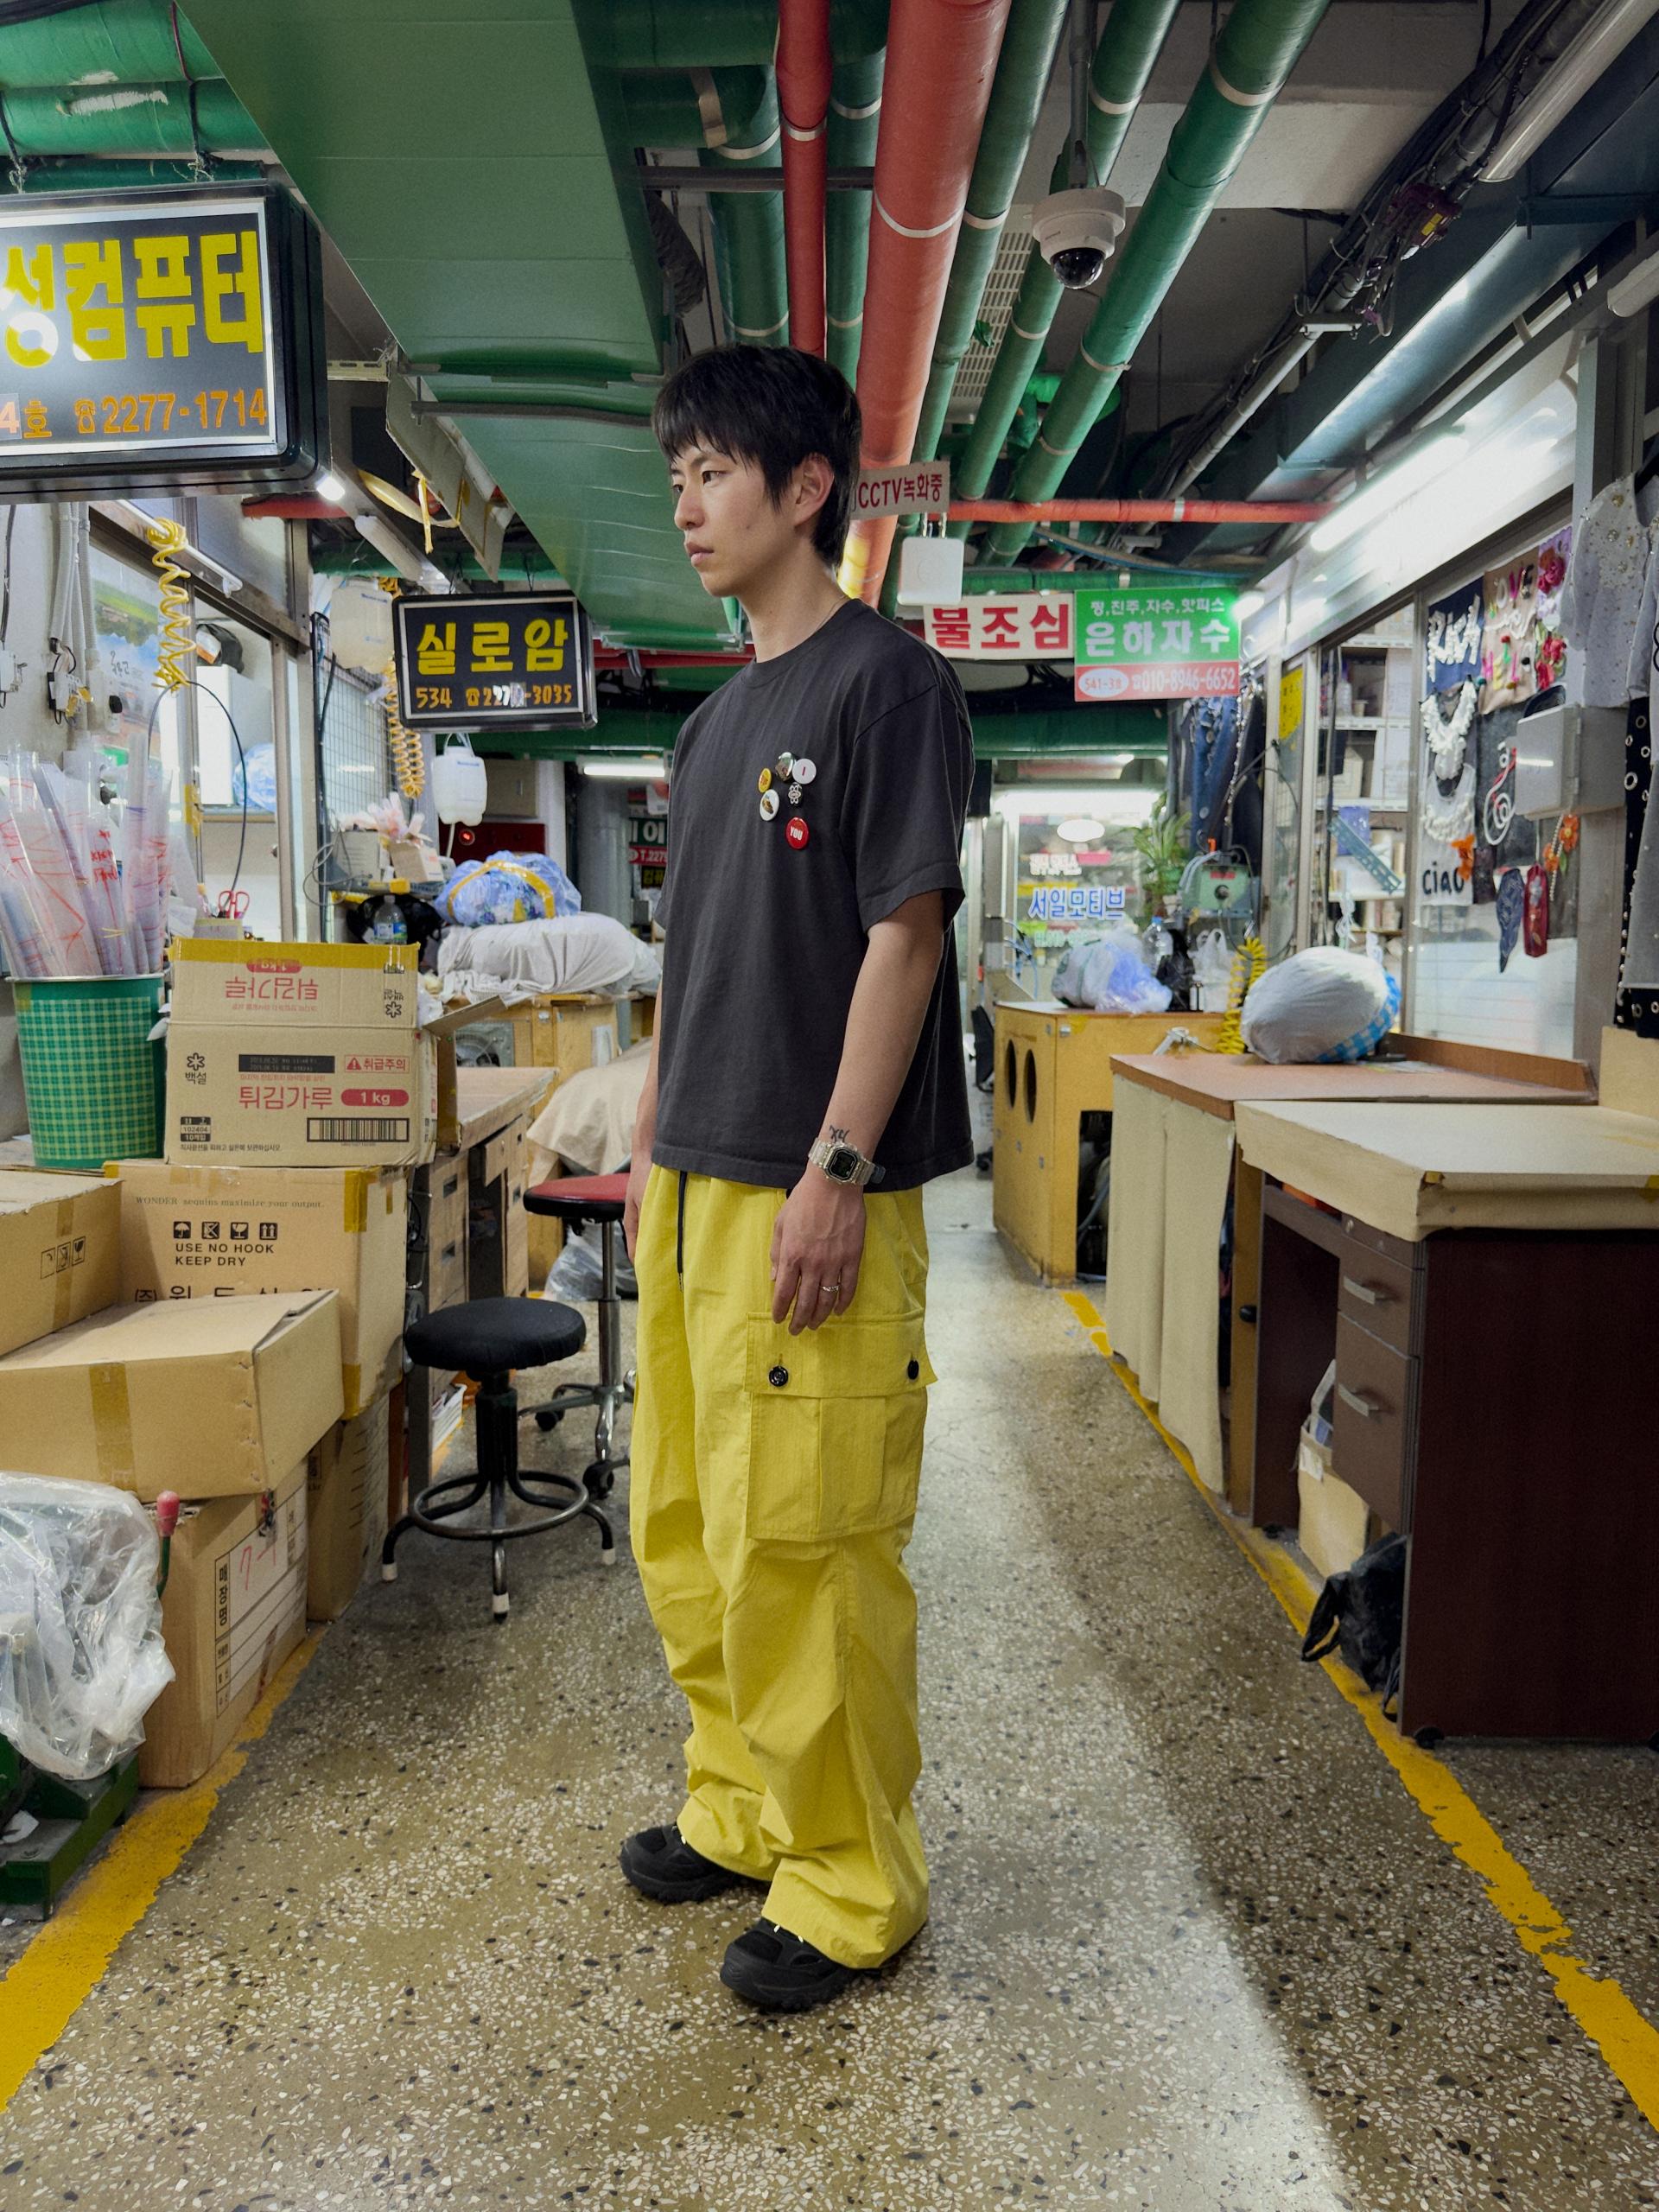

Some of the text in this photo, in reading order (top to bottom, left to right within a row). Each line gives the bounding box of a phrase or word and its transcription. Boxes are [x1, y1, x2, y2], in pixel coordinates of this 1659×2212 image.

[0, 231, 264, 368] 성컴퓨터
[102, 389, 267, 434] 2277-1714
[858, 474, 943, 509] CCTV녹화중
[931, 604, 1069, 650] 불조심
[1085, 620, 1230, 657] 은하자수
[416, 619, 569, 676] 실로암
[416, 686, 453, 709] 534
[1029, 887, 1125, 920] 서일모티브
[225, 976, 319, 1001] 튀김가루
[185, 1072, 207, 1085] 백설
[363, 1057, 407, 1071] 취급주의
[238, 1086, 334, 1110] 튀김가루
[372, 1091, 391, 1106] kg
[175, 1243, 275, 1254] USE NO HOOK
[175, 1255, 247, 1267] KEEP DRY
